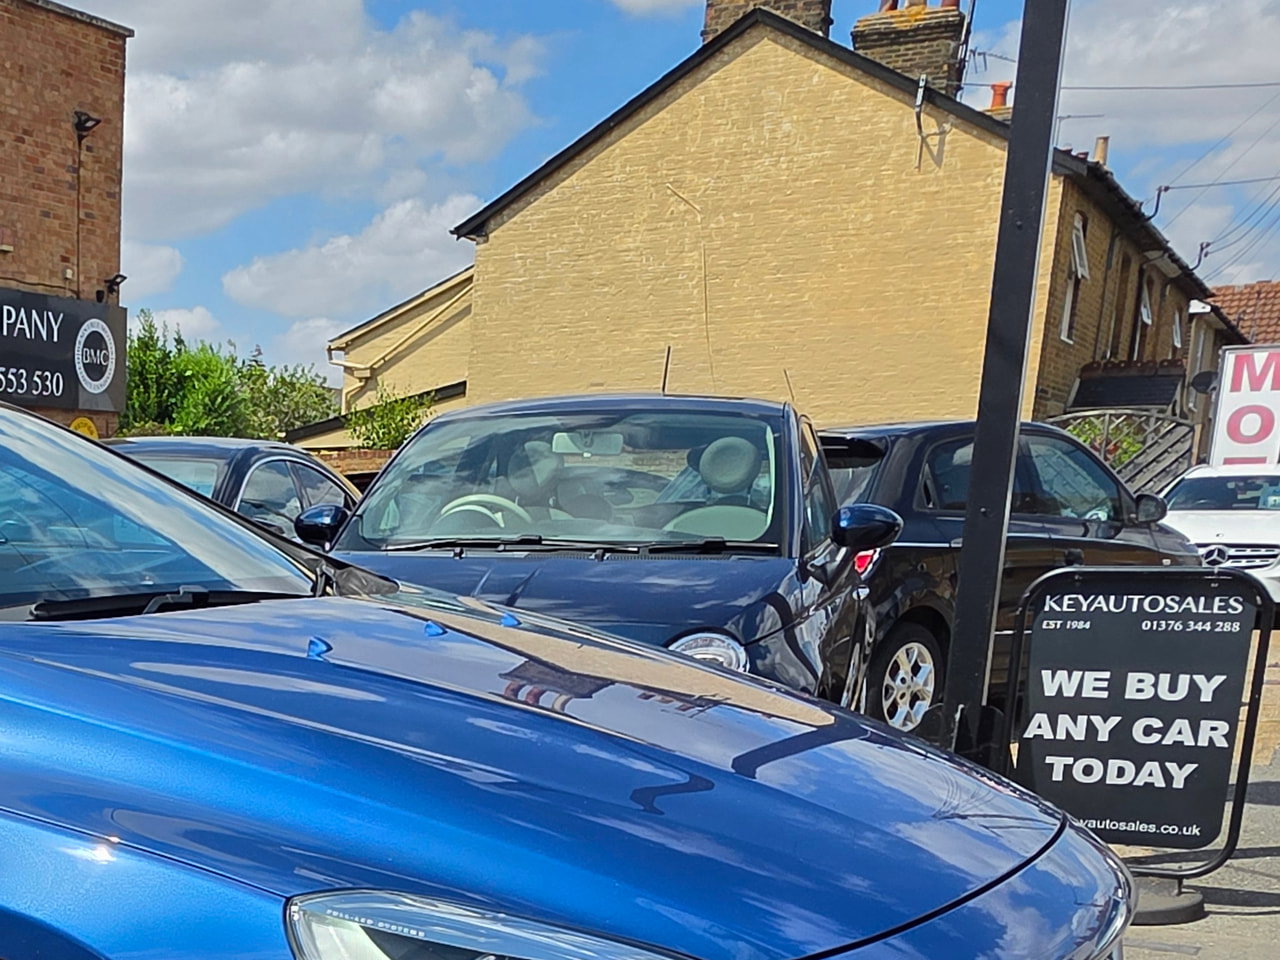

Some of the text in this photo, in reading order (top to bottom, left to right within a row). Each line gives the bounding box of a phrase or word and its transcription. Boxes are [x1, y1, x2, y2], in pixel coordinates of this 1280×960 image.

[82, 347, 109, 366] BMC
[31, 370, 64, 397] 530
[1043, 594, 1244, 614] KEYAUTOSALES
[1041, 620, 1091, 630] EST 1984
[1141, 620, 1241, 633] 01376 344 288
[1040, 669, 1227, 702] WE BUY
[1022, 712, 1230, 748] ANY CAR
[1044, 755, 1199, 789] TODAY
